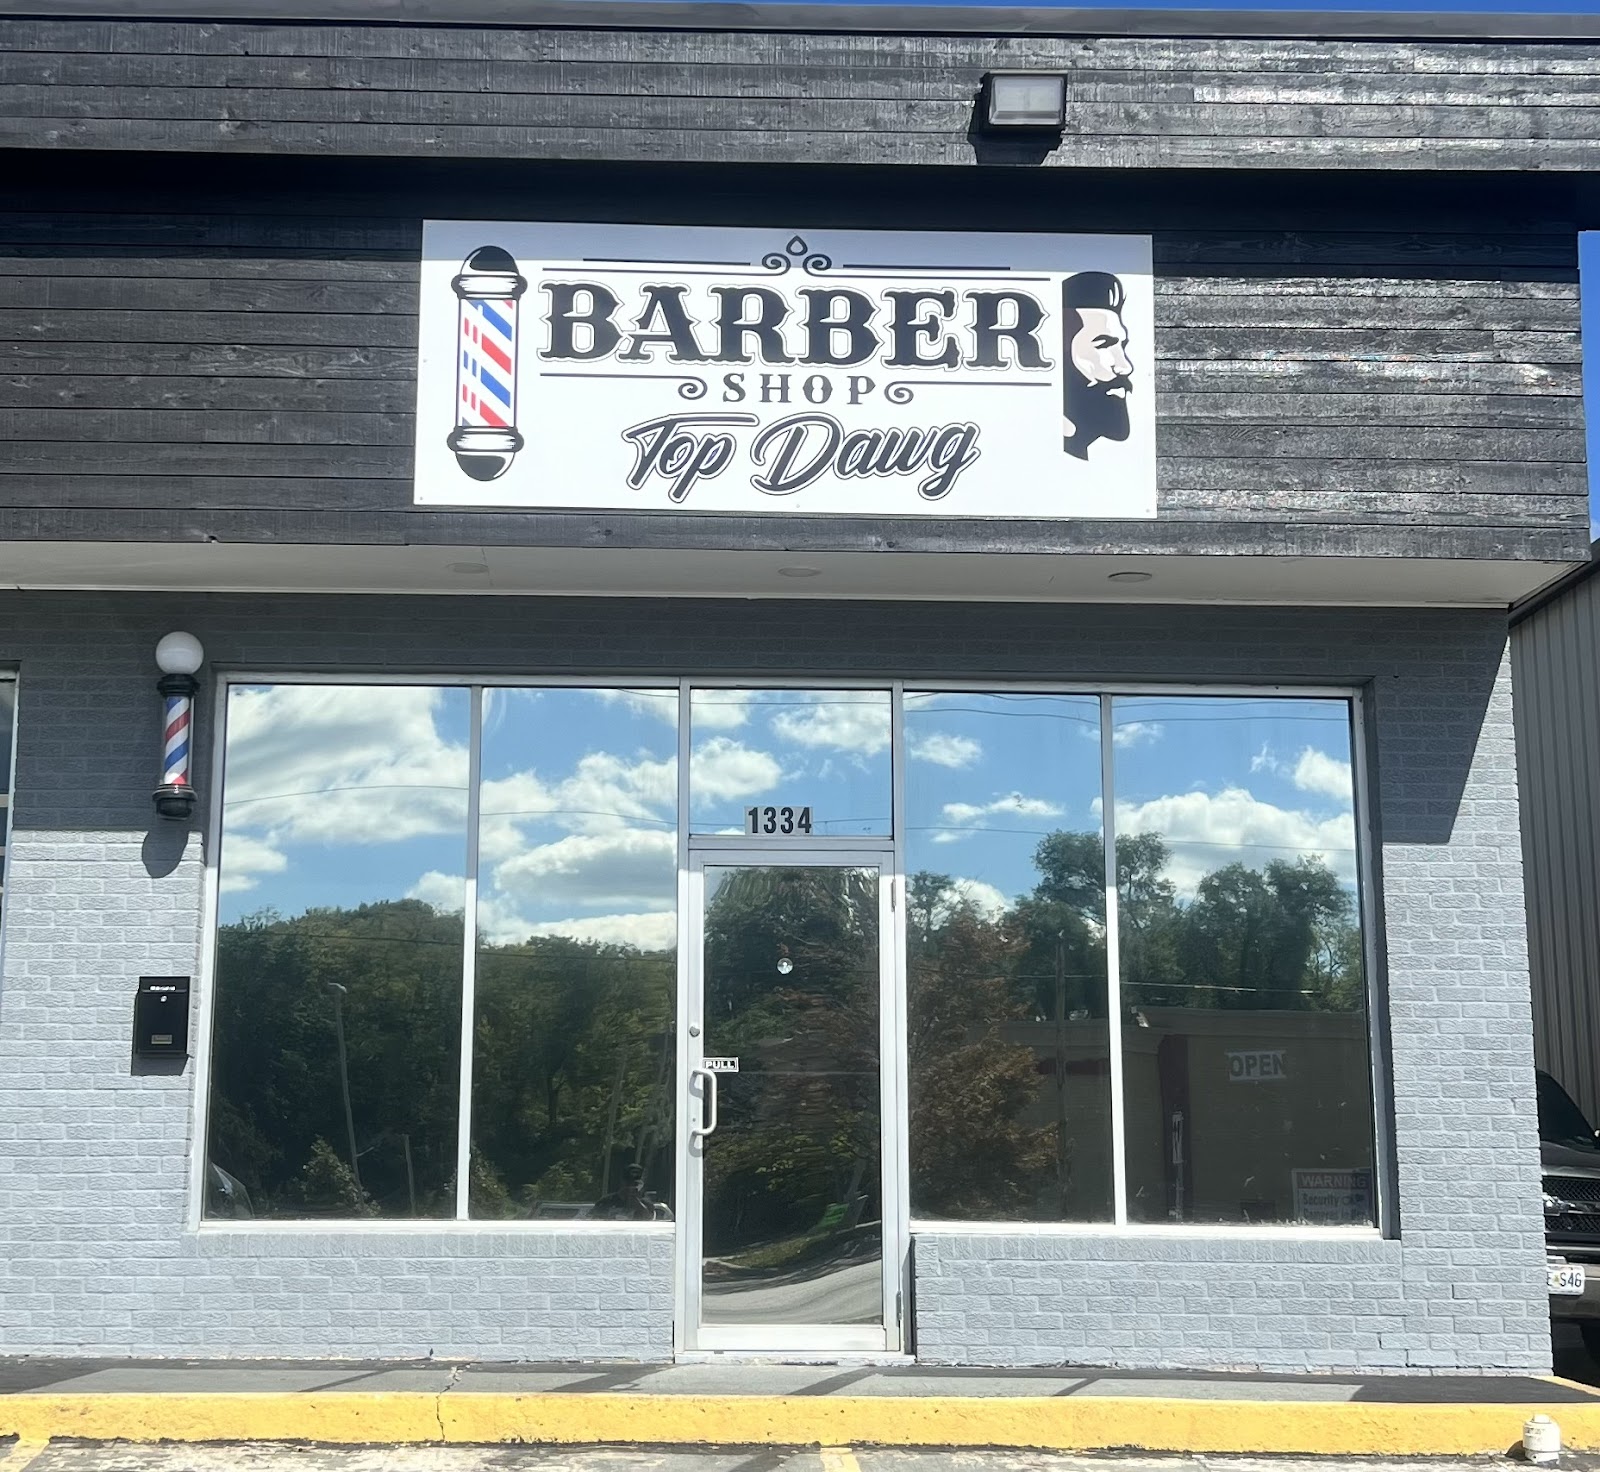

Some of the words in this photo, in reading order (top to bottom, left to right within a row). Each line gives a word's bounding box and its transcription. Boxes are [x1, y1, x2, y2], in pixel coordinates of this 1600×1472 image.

[539, 281, 1051, 369] BARBER
[723, 373, 876, 406] SHOP
[622, 413, 760, 503] Top
[751, 413, 981, 501] Dawg
[748, 806, 812, 834] 1334
[705, 1060, 736, 1070] PULL
[1229, 1053, 1288, 1078] OPEN
[1301, 1175, 1367, 1188] WARNING
[1303, 1193, 1340, 1207] Security
